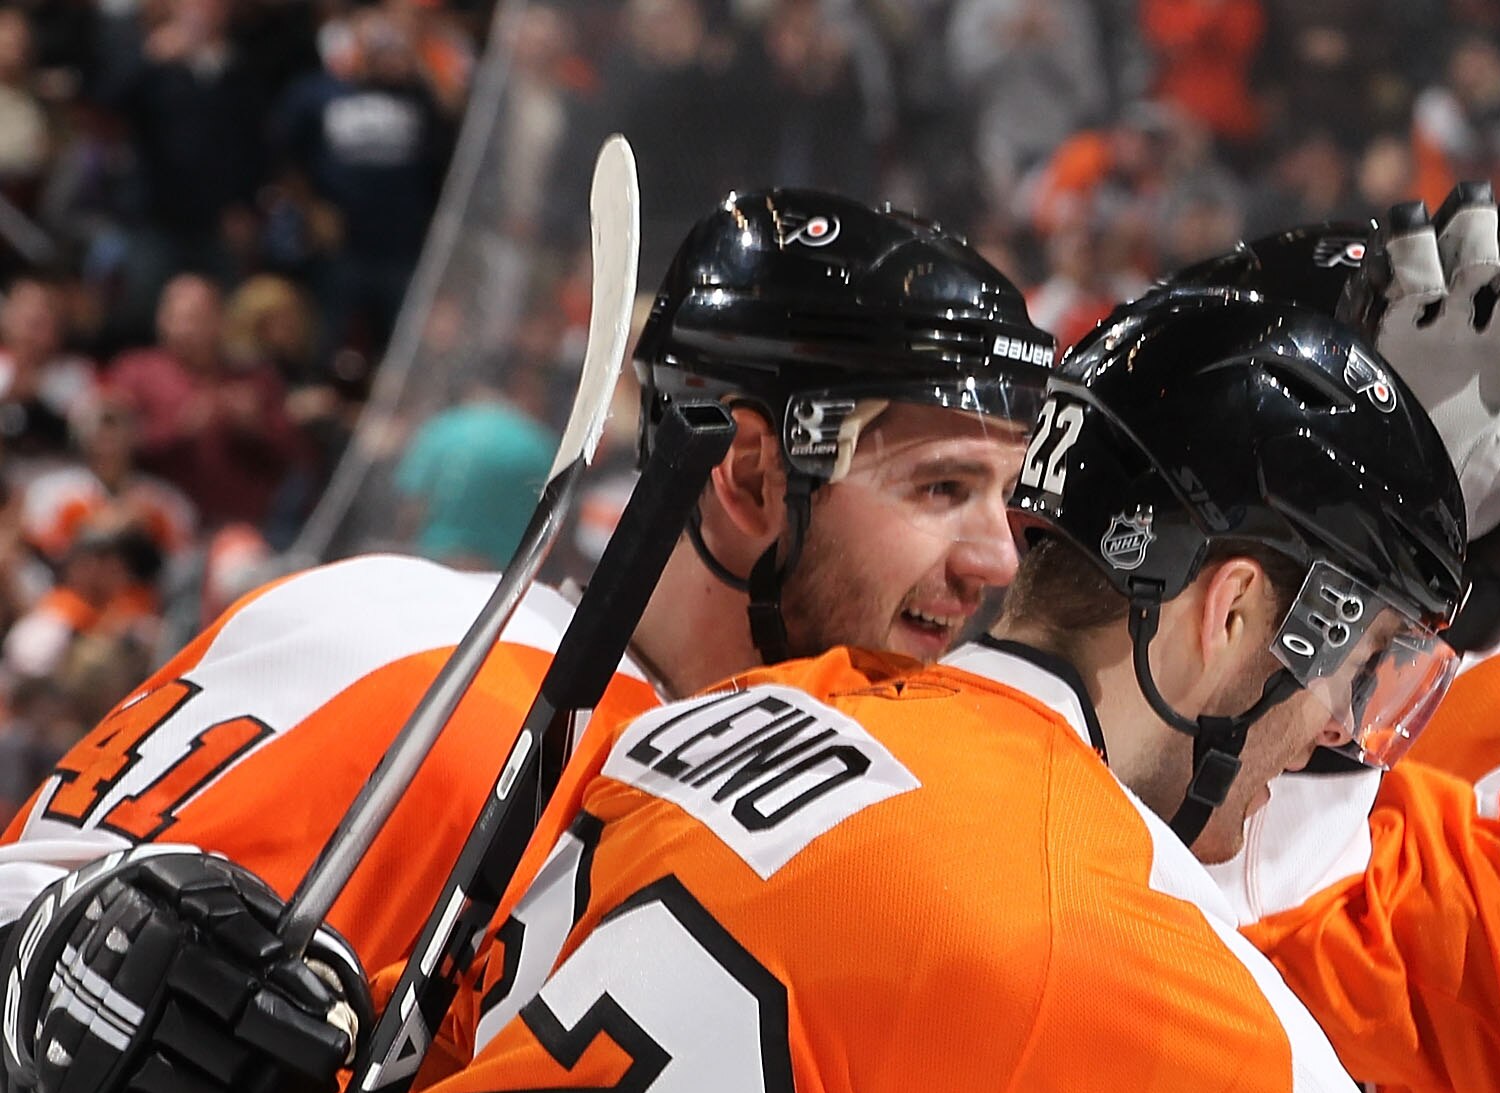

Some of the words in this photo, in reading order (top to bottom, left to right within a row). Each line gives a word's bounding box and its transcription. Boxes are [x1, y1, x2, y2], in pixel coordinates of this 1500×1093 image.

[992, 335, 1054, 369] BAUER
[1020, 399, 1084, 496] 22
[1109, 534, 1144, 554] NHL
[41, 677, 277, 845] 41
[625, 687, 872, 834] LEINO
